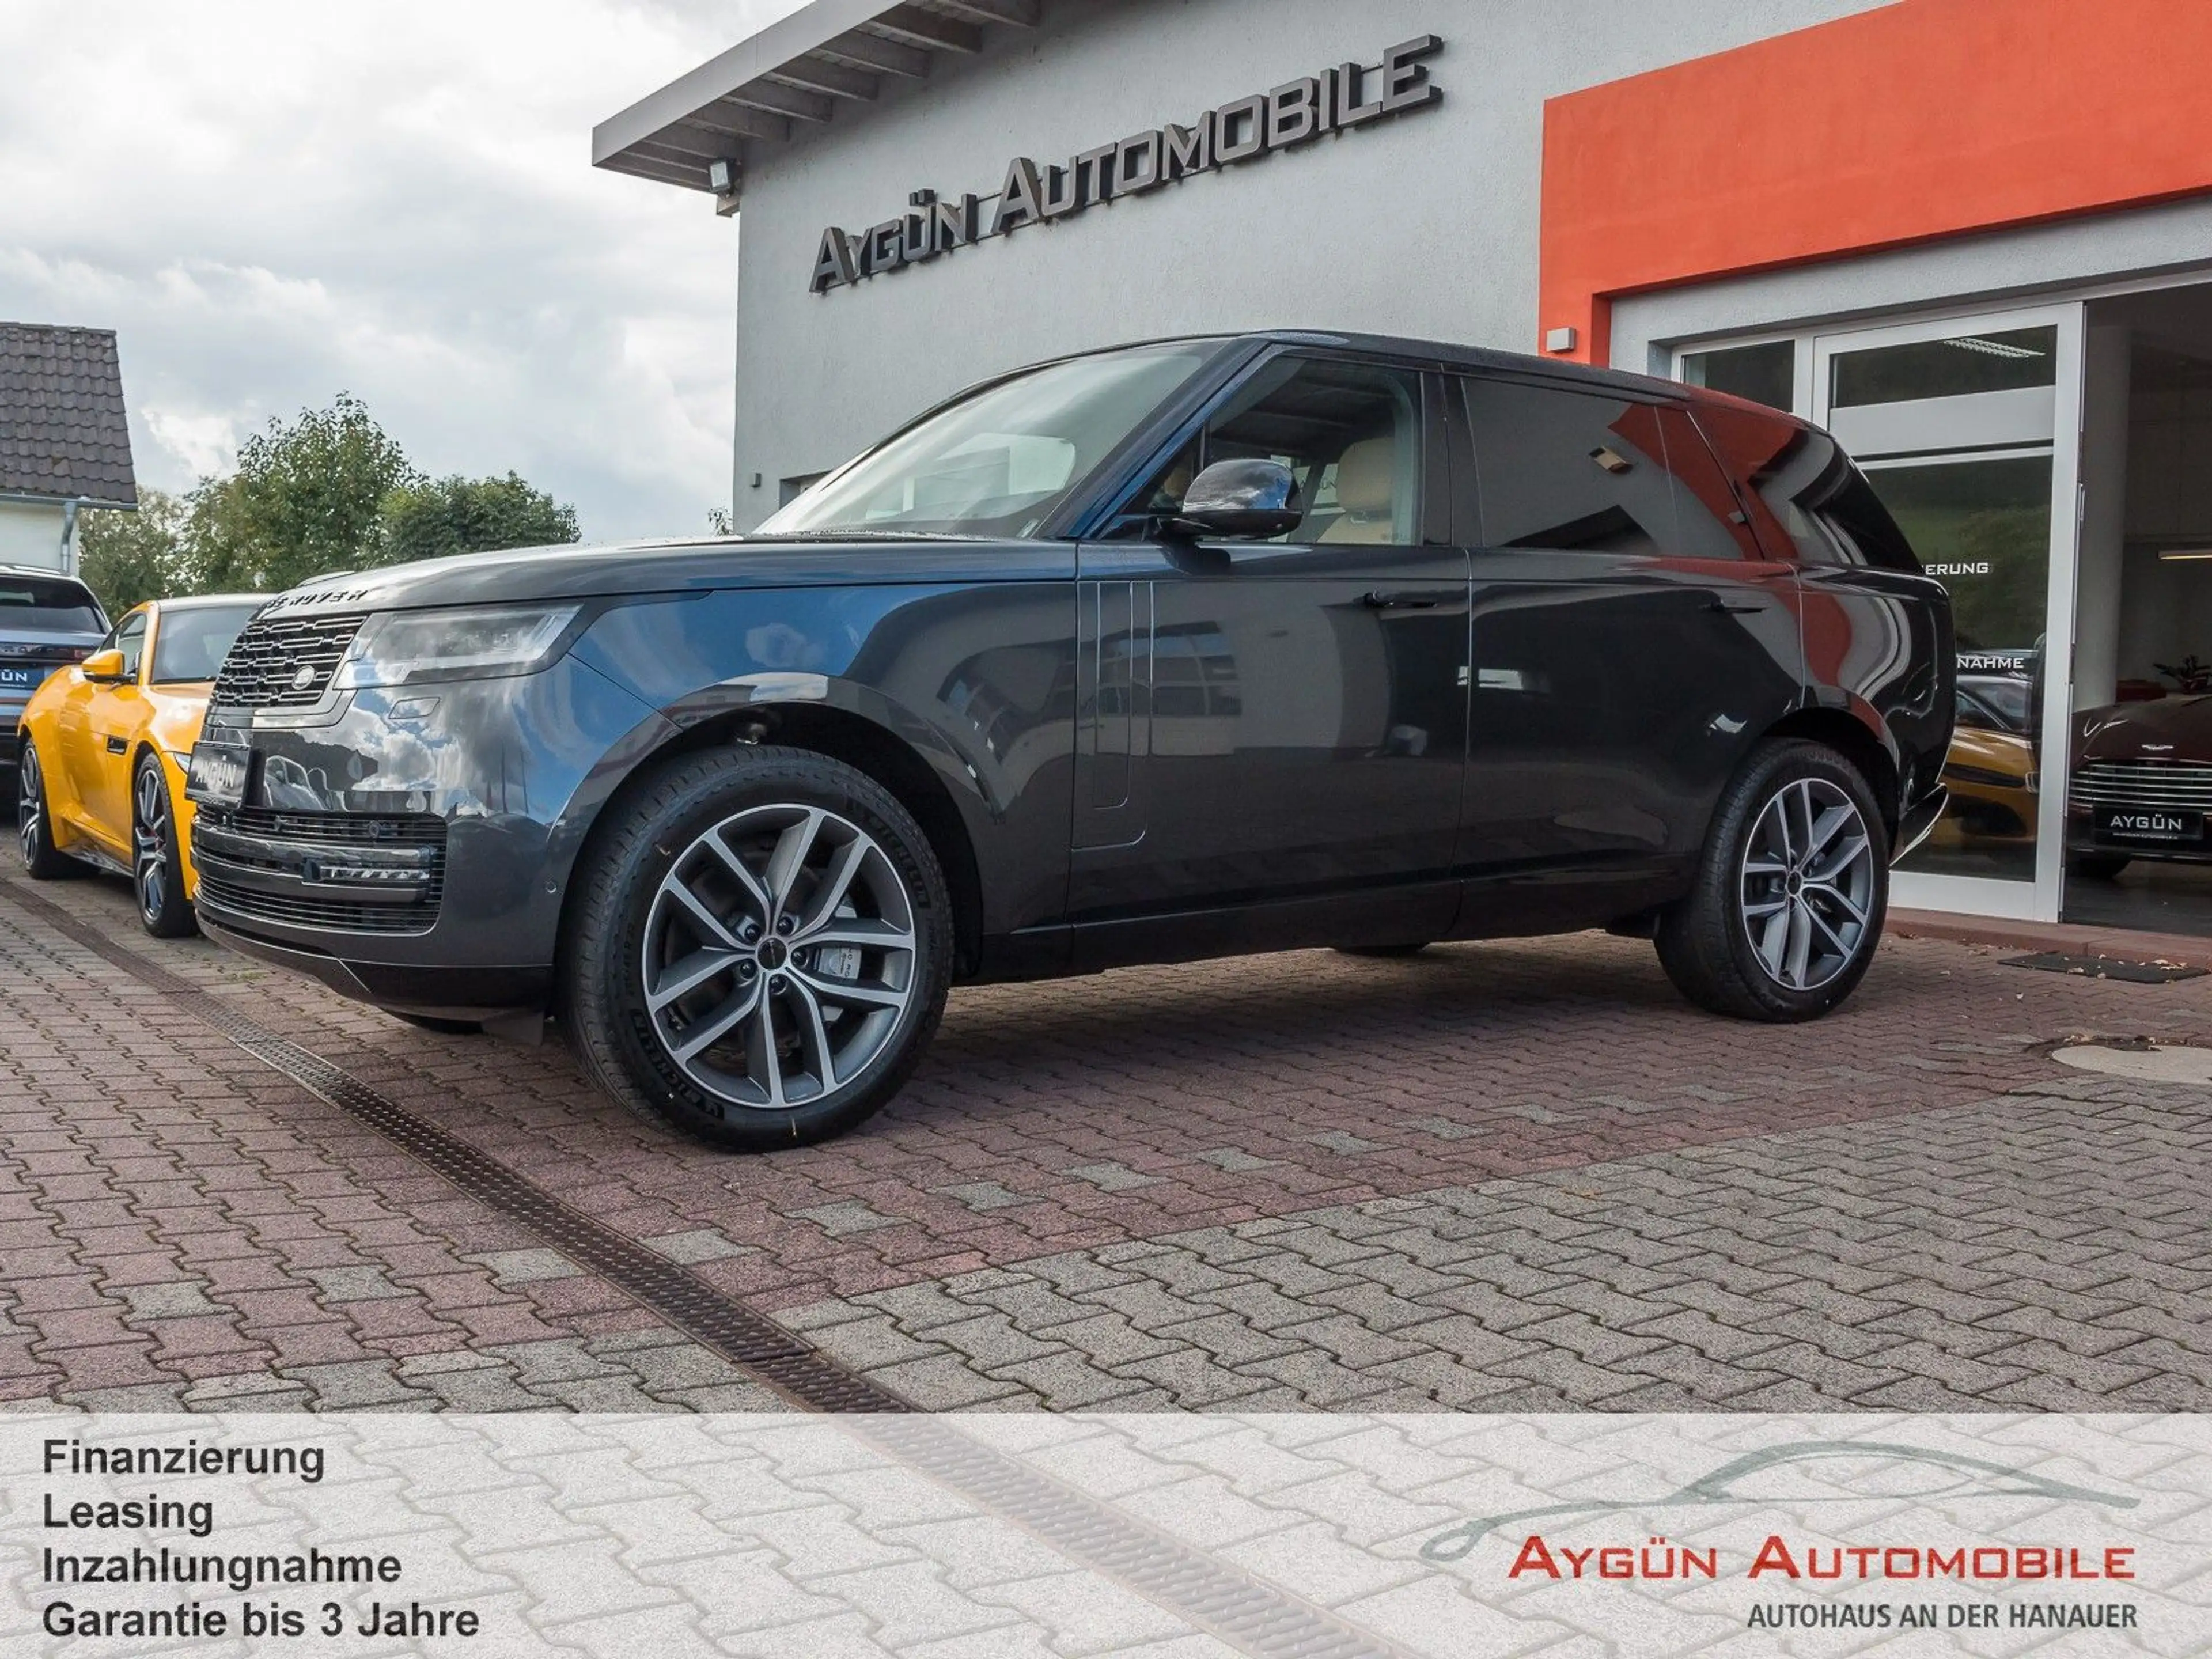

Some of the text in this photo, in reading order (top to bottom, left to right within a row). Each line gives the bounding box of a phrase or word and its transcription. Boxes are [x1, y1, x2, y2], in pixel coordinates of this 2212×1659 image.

[809, 34, 1442, 293] AYGÜN AUTOMOBILE
[1922, 563, 1988, 575] ERUNG
[1957, 658, 2024, 669] NAHME
[2111, 813, 2182, 831] AYGÜN
